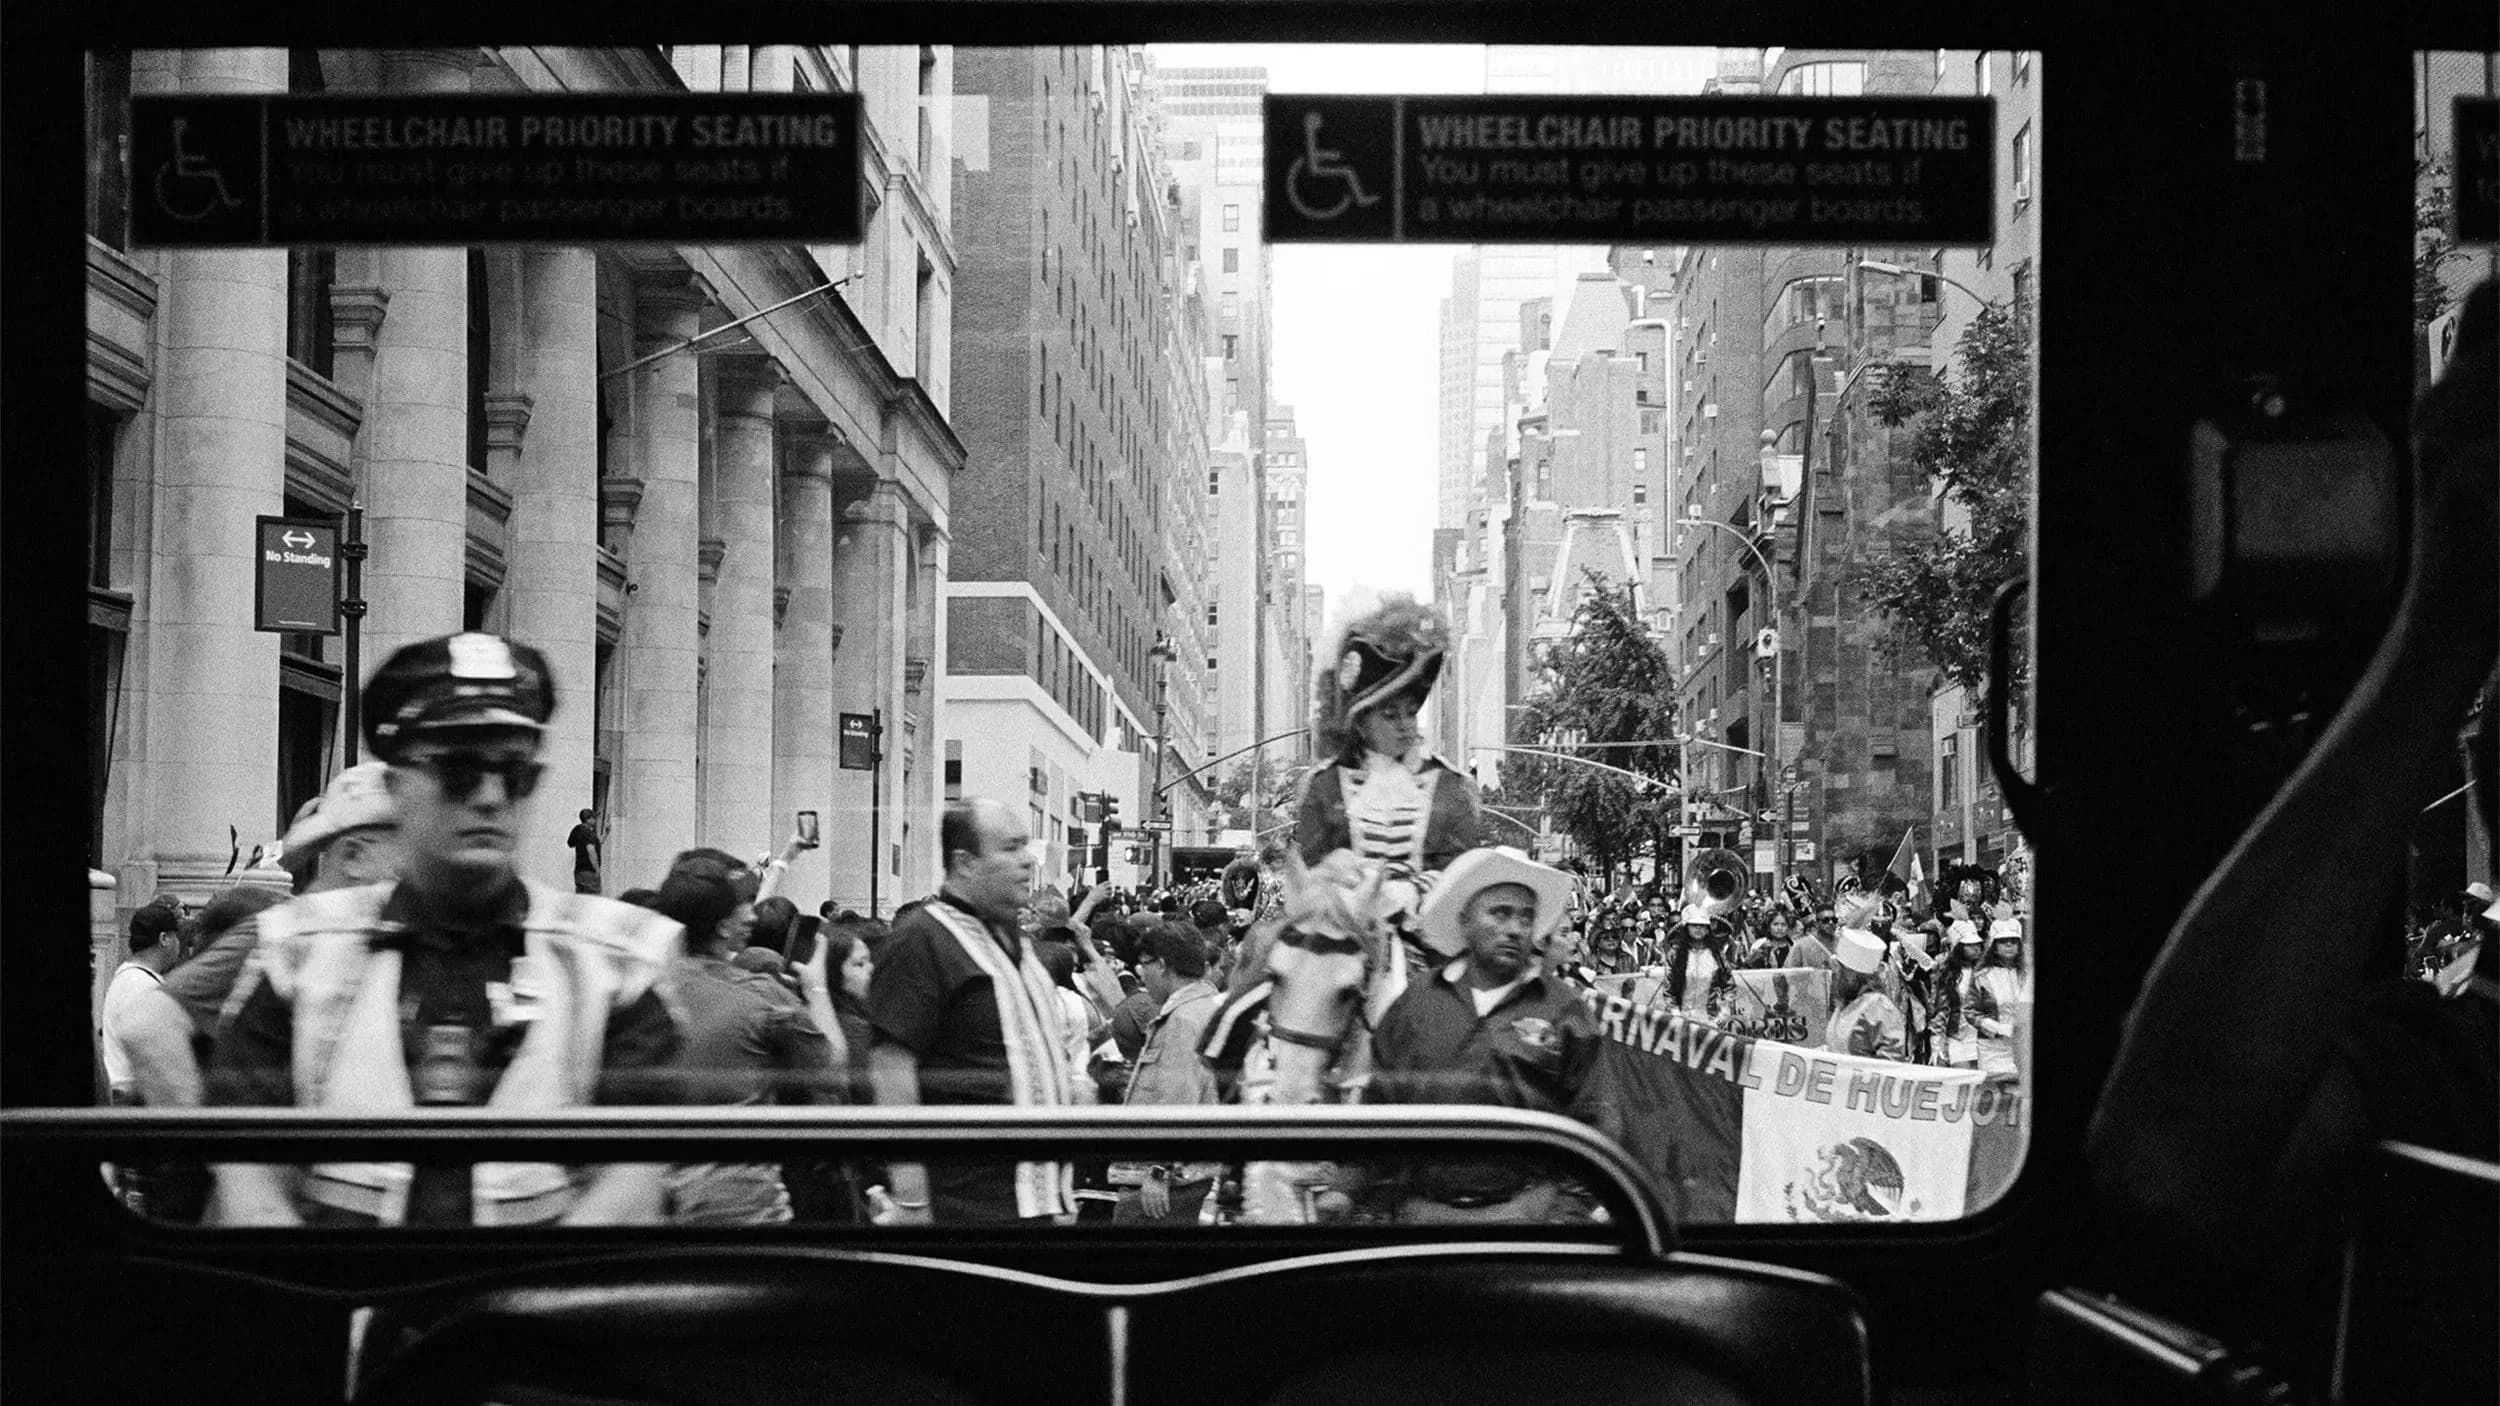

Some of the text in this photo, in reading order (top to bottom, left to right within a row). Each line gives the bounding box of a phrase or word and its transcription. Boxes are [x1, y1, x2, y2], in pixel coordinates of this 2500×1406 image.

[284, 114, 837, 148] WHEELCHAIR PRIORITY SEATING
[1418, 115, 1969, 151] WHEELCHAIR PRIORITY SEATING
[1418, 153, 1924, 192] You must give up these seats if
[1418, 198, 1440, 223] a
[1447, 193, 1623, 224] wheelchair
[1632, 196, 1799, 230] passenger
[265, 550, 331, 568] No Standing
[1775, 1050, 1837, 1104] DE
